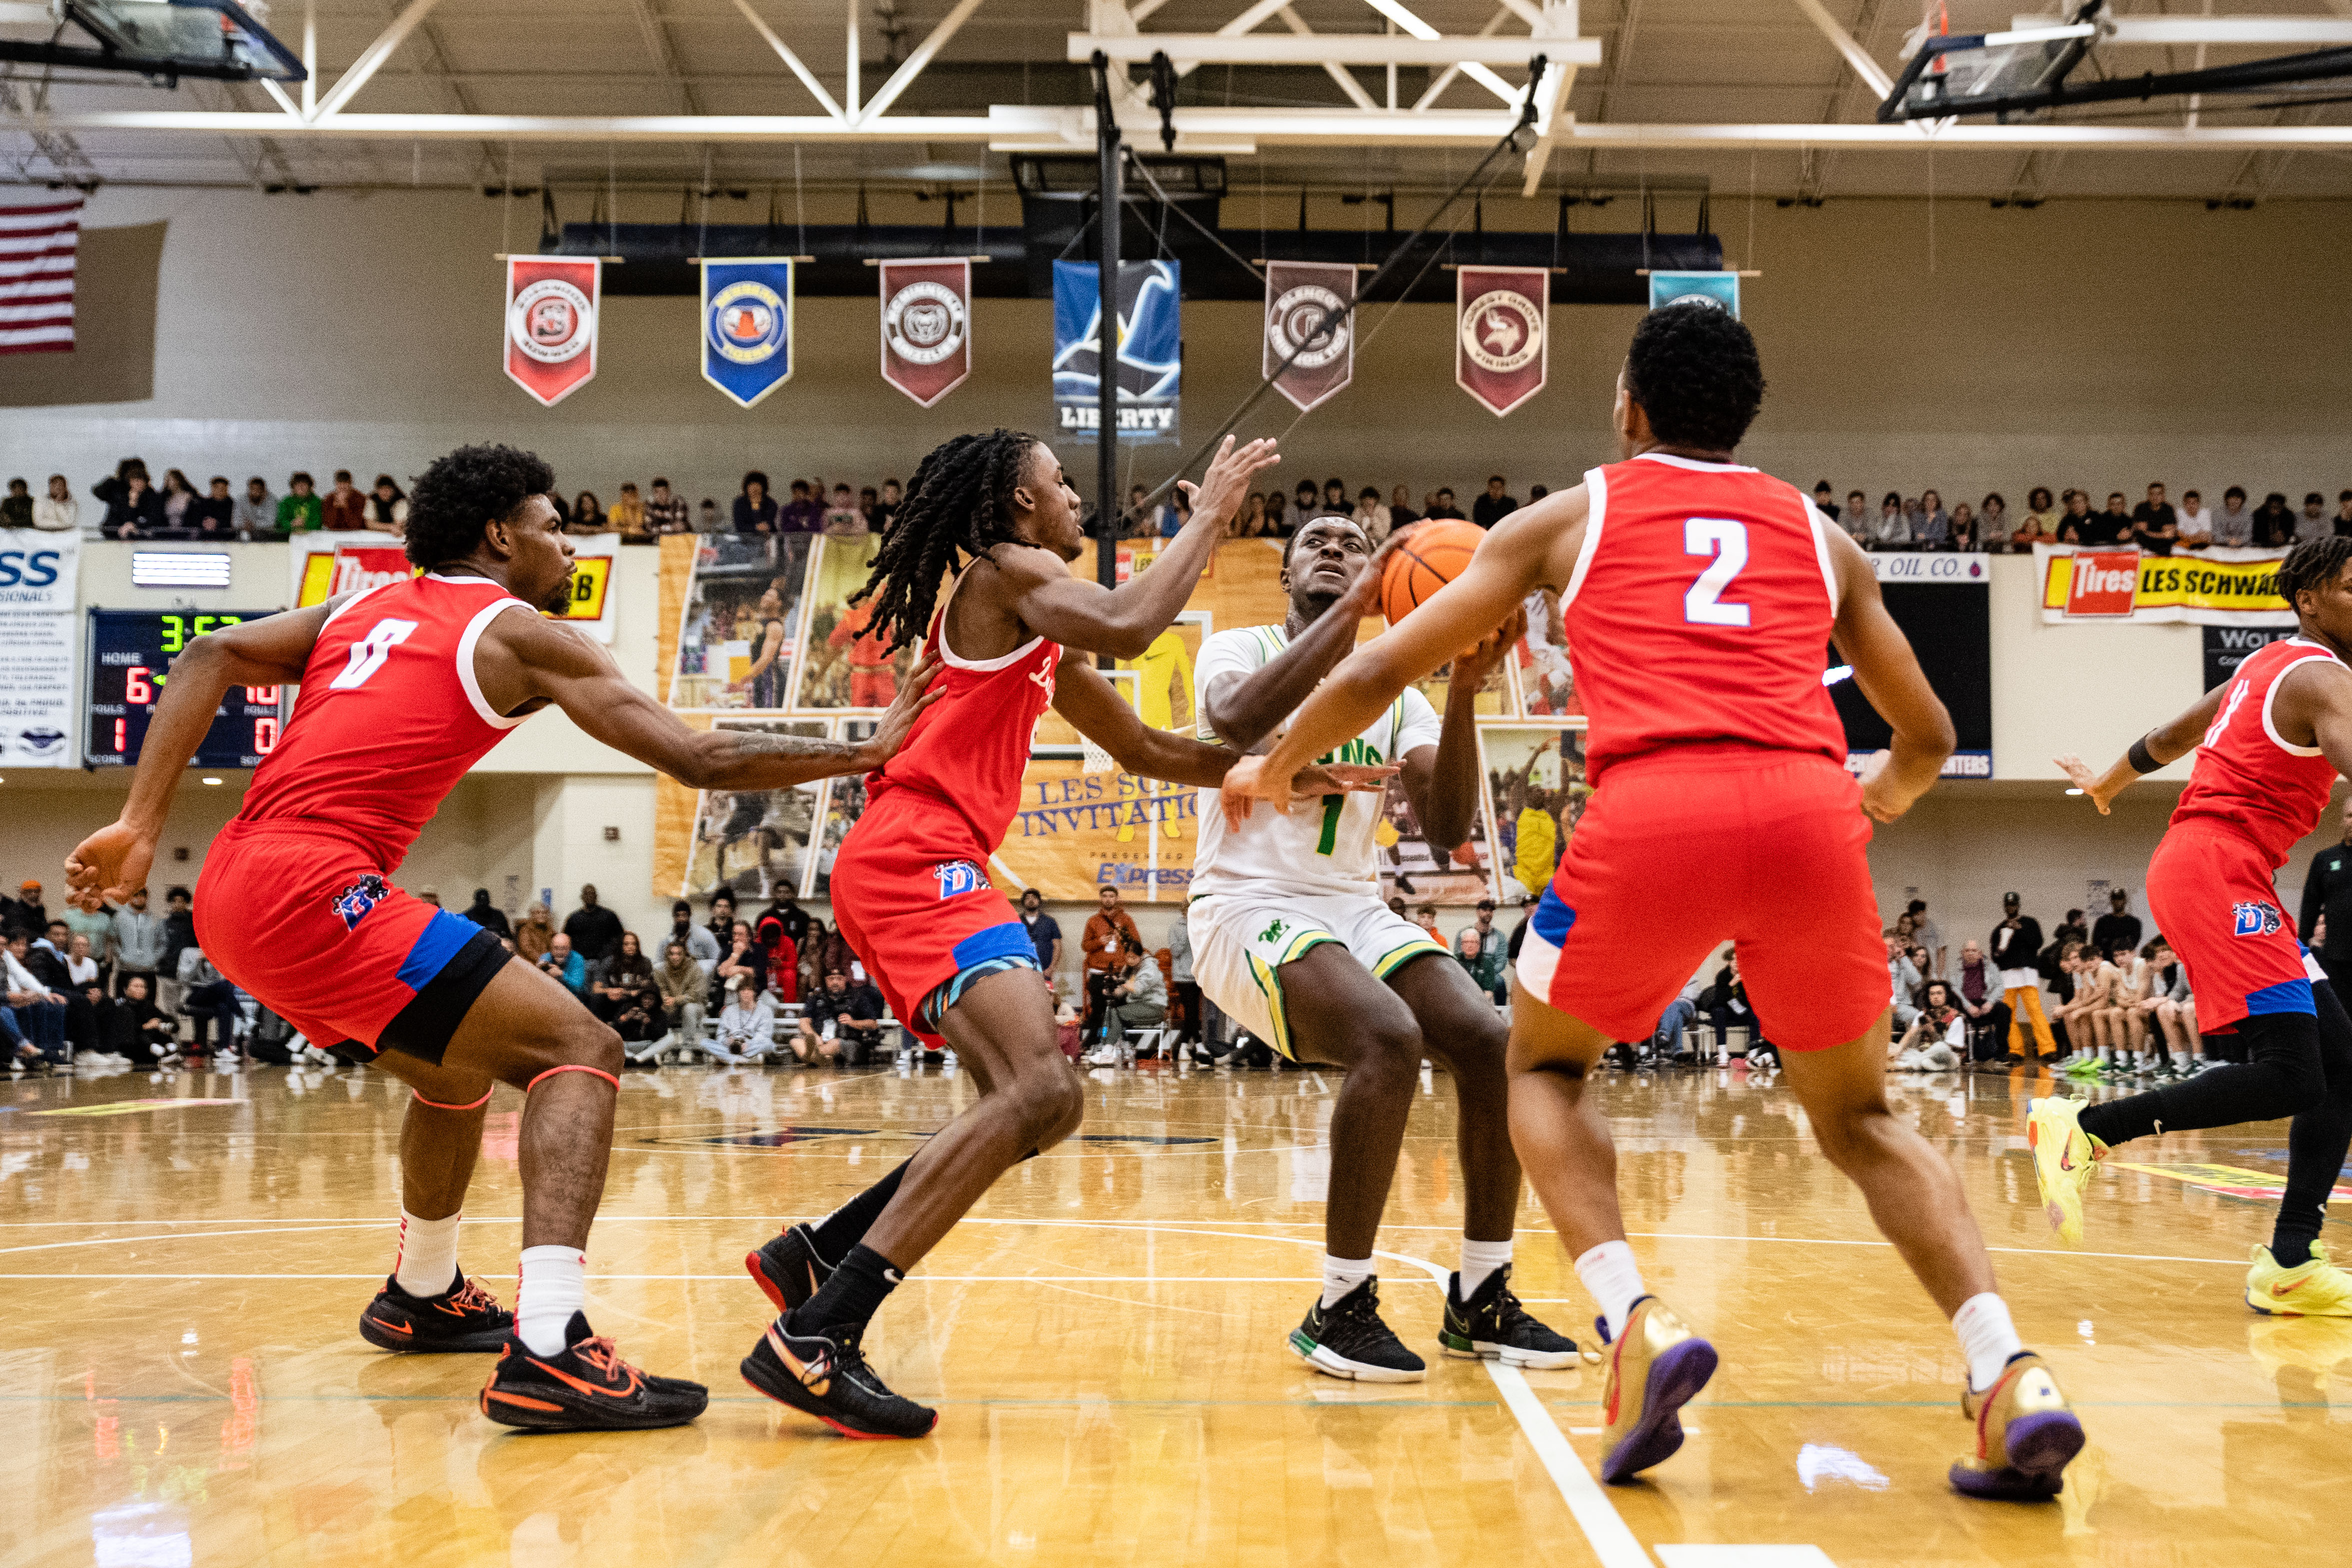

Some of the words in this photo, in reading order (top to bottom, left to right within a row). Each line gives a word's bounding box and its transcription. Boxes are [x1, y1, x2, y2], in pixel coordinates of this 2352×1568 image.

[1061, 406, 1174, 428] LIBRTY
[1684, 517, 1750, 626] 2
[1890, 557, 1923, 576] OIL
[1931, 557, 1962, 576] CO.
[2075, 558, 2136, 598] Tires
[2141, 568, 2181, 593] LES
[101, 652, 142, 666] HOME
[330, 618, 418, 689] 0
[127, 666, 151, 704] 6
[114, 717, 126, 752] 1
[255, 717, 278, 755] 0
[1036, 776, 1103, 805] LES
[2234, 906, 2264, 936] D
